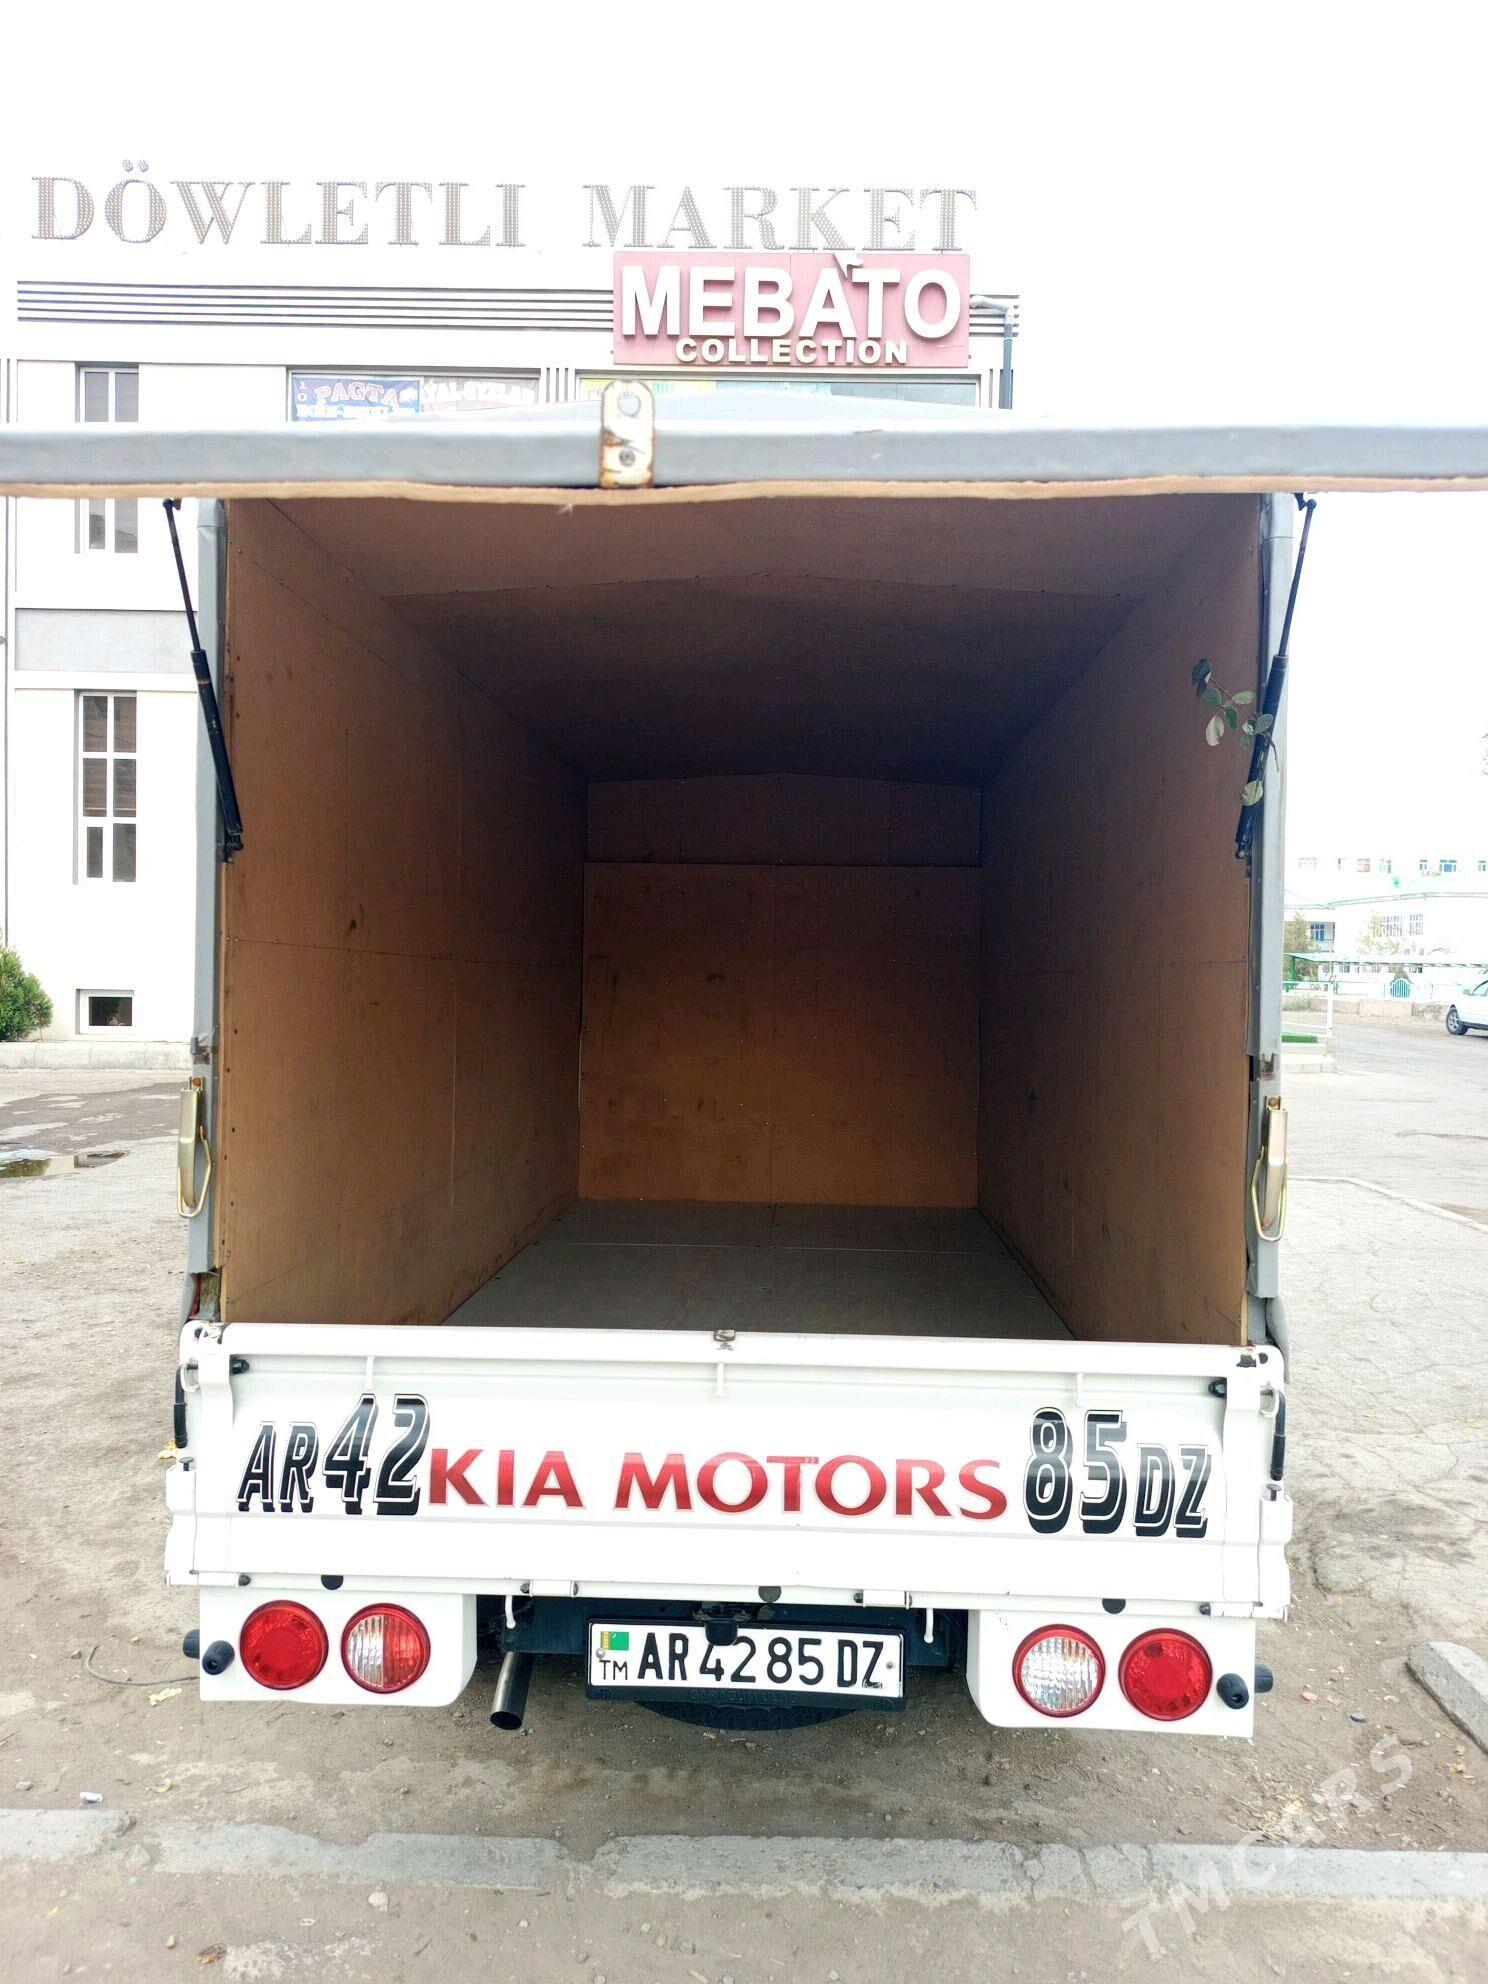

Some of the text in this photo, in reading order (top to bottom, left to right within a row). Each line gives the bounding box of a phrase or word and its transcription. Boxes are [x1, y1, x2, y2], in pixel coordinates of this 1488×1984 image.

[31, 159, 977, 251] DÖWLETLI MARKET
[620, 262, 963, 340] MEBATO
[675, 337, 908, 365] COLLECTION
[428, 1448, 586, 1507] KIA
[612, 1450, 1009, 1521] MOTORS
[599, 1659, 629, 1681] TM
